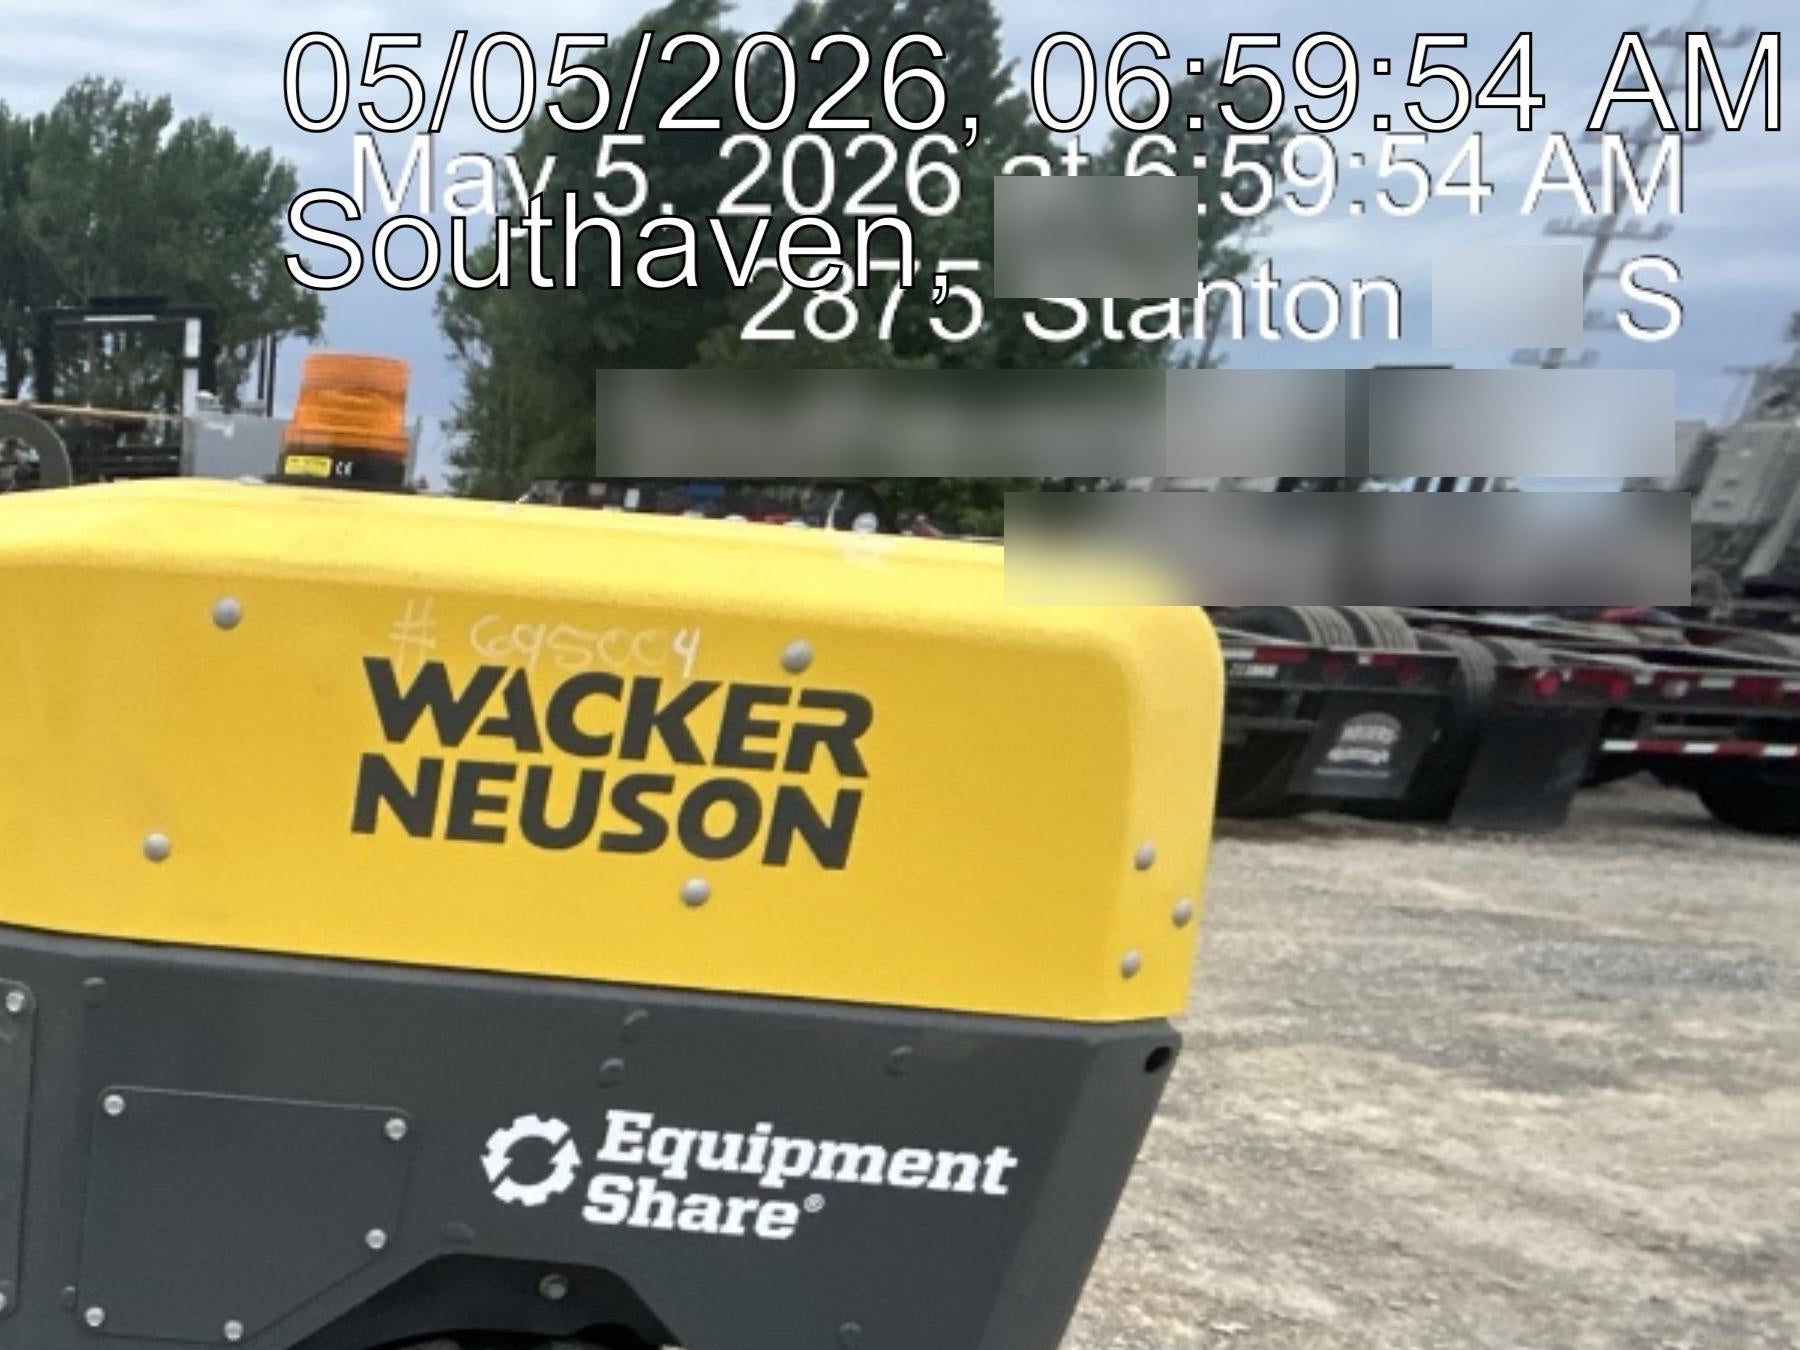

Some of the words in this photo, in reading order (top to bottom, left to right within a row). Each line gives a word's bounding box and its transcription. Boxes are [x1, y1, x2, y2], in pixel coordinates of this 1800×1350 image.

[361, 655, 875, 778] WACKER
[350, 752, 863, 871] NEUSON
[597, 1109, 1018, 1195] Equipment
